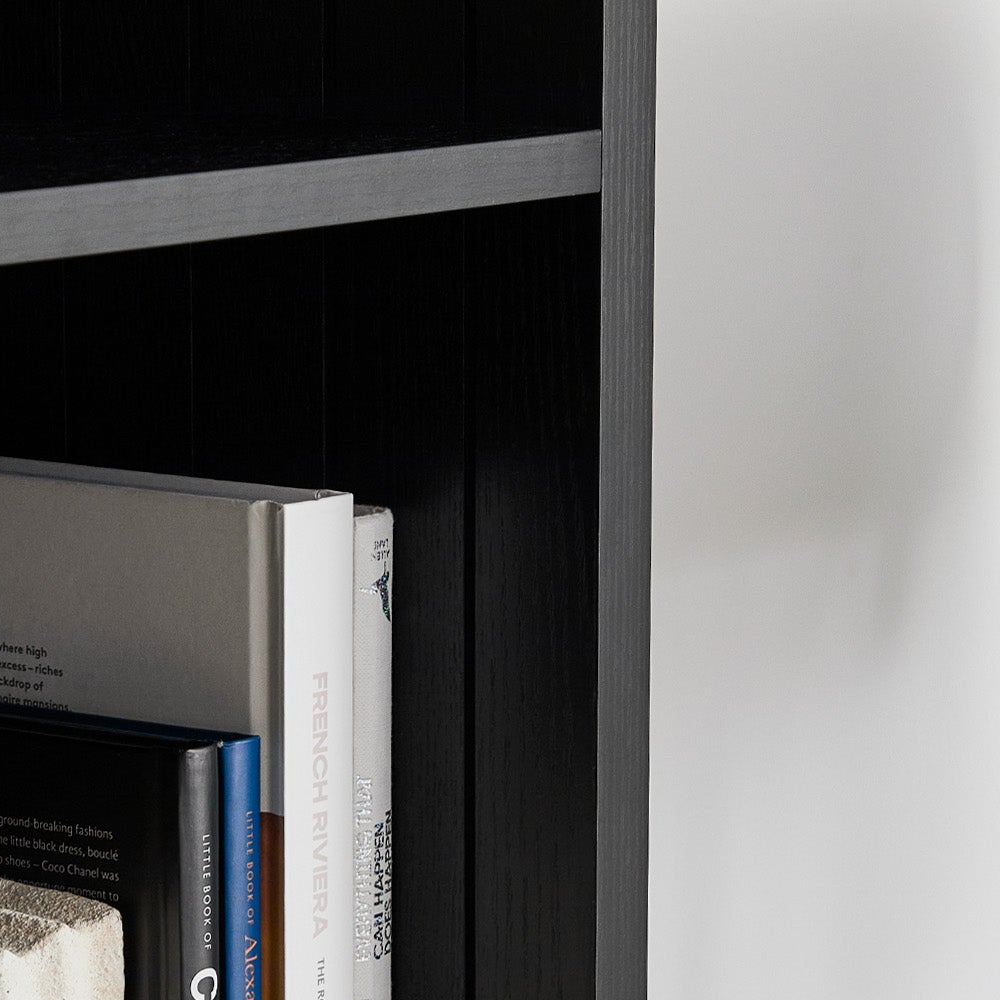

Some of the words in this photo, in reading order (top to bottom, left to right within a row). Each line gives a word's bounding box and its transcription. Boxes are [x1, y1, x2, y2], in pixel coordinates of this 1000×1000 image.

[26, 645, 48, 660] high
[33, 680, 44, 692] of
[312, 671, 328, 804] FRENCH
[75, 823, 114, 840] fashions
[246, 810, 254, 856] LITTLE
[10, 835, 31, 848] little
[32, 838, 57, 852] black
[58, 842, 86, 858] dress,
[202, 833, 212, 879] LITTLE
[5, 855, 31, 869] shoes
[41, 859, 65, 874] Coco
[67, 863, 100, 879] Chanel
[101, 870, 120, 881] was
[312, 810, 328, 940] RIVIERA
[373, 822, 384, 907] HAPPEN
[246, 861, 254, 901] BOOK
[108, 891, 119, 902] to
[202, 885, 212, 927] BOOK
[247, 907, 255, 924] OF
[203, 931, 212, 950] OF
[373, 911, 383, 960] CAN
[317, 957, 325, 986] THE
